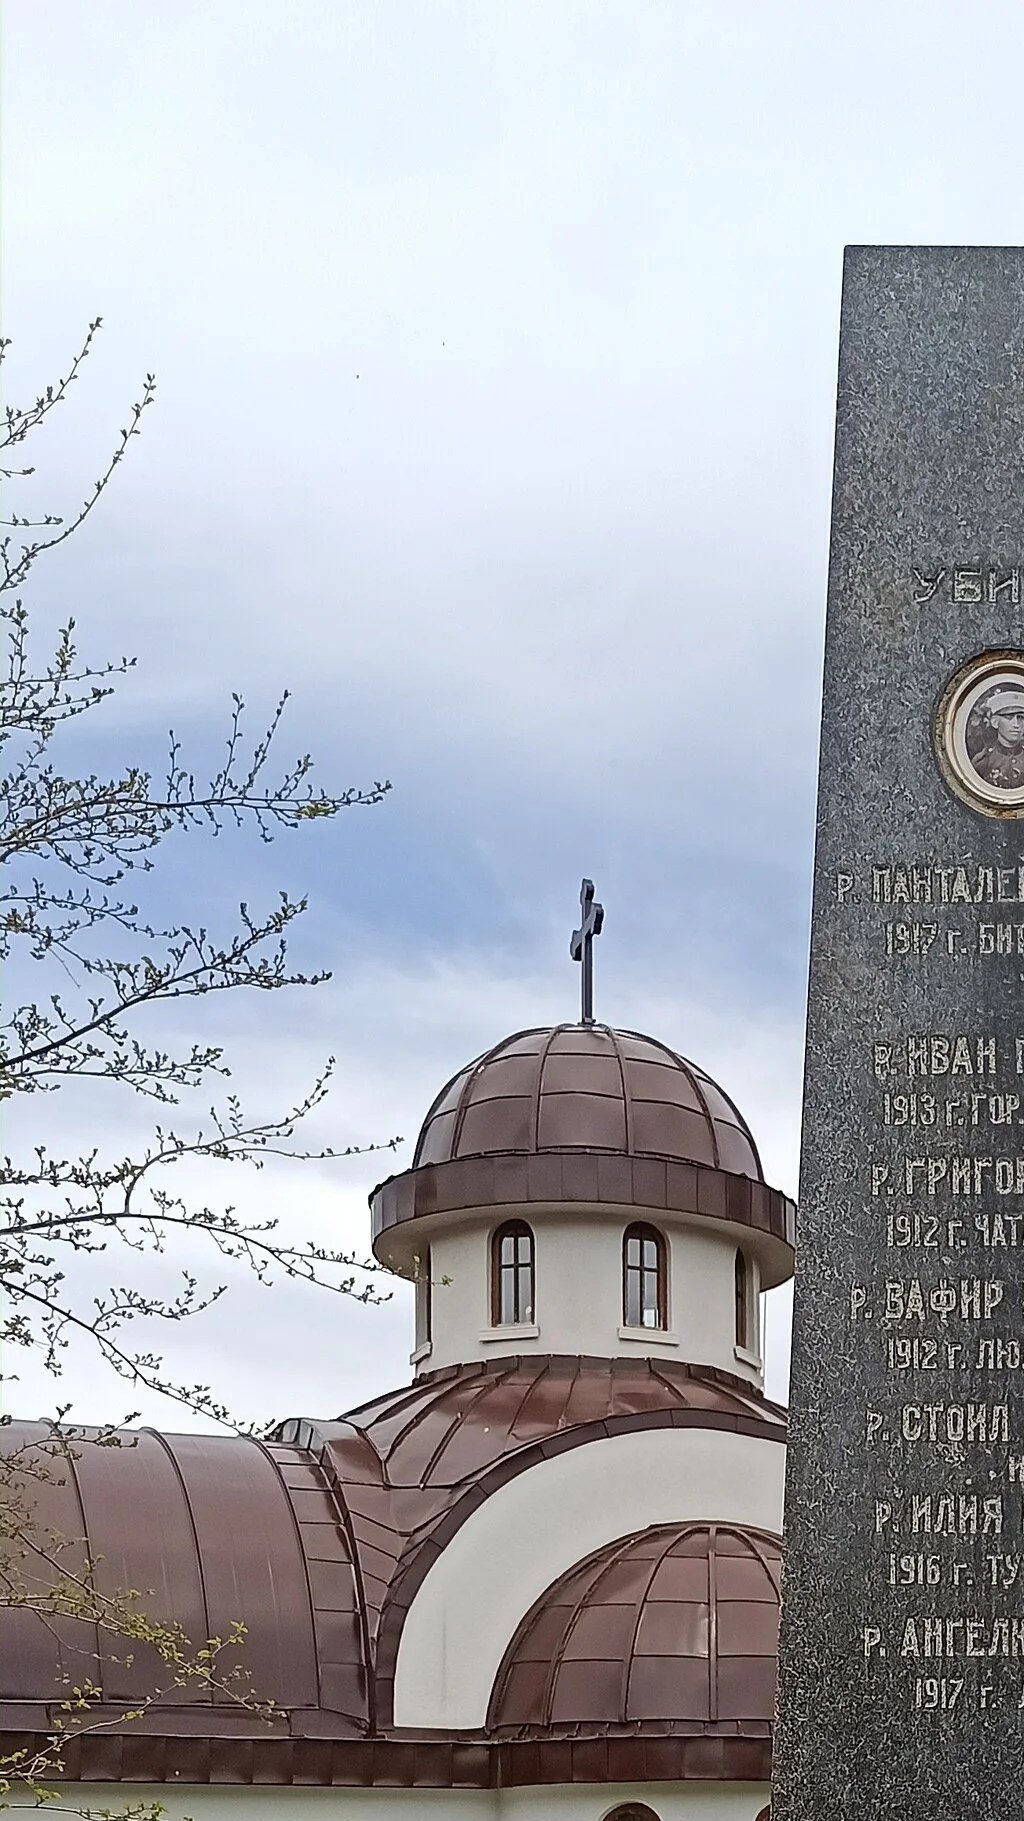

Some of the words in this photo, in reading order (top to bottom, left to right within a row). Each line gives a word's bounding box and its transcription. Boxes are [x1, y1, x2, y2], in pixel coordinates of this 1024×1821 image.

[885, 921, 939, 954] 1917
[907, 1034, 997, 1075] ИВАН
[883, 1092, 936, 1126] 1913
[886, 1213, 939, 1248] 1912
[885, 1279, 1004, 1320] ВАФИР
[887, 1337, 938, 1369] 1912
[902, 1402, 1010, 1442] СТОИЛ
[911, 1495, 1003, 1535] ИЛИЯ
[889, 1552, 941, 1586] 1916
[915, 1677, 964, 1709] 1917
